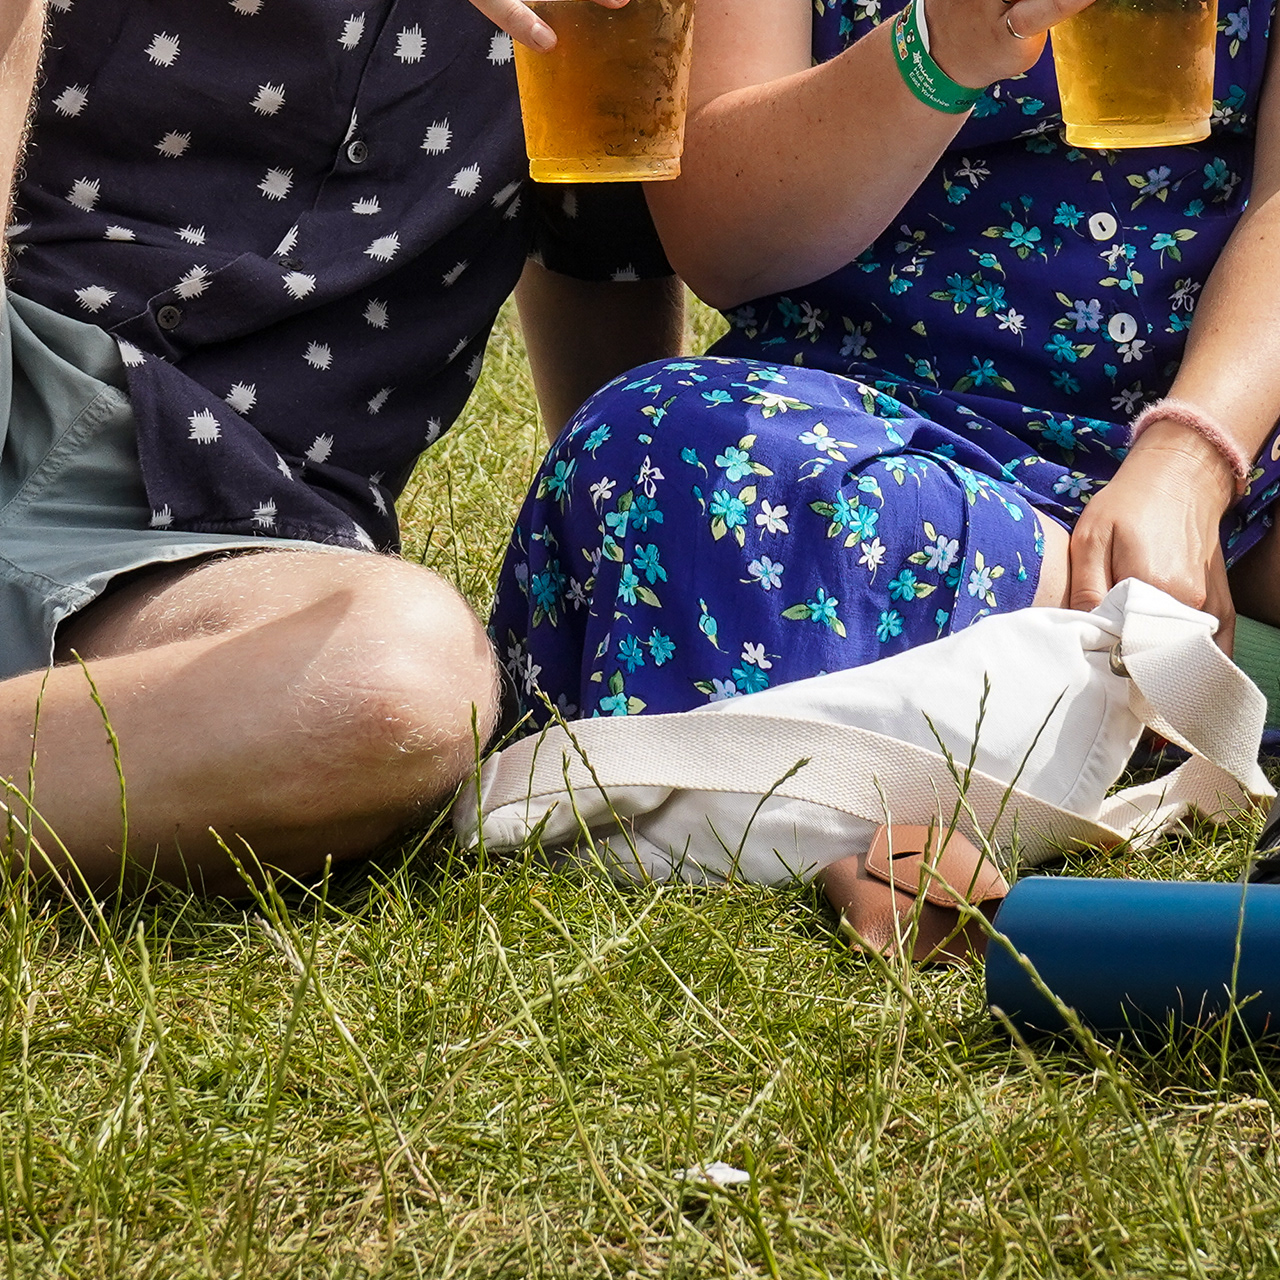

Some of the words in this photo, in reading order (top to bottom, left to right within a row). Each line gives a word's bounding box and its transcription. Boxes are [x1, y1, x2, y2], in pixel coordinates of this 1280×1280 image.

[909, 71, 921, 88] East
[921, 86, 950, 107] Yorkshire
[923, 81, 936, 93] and
